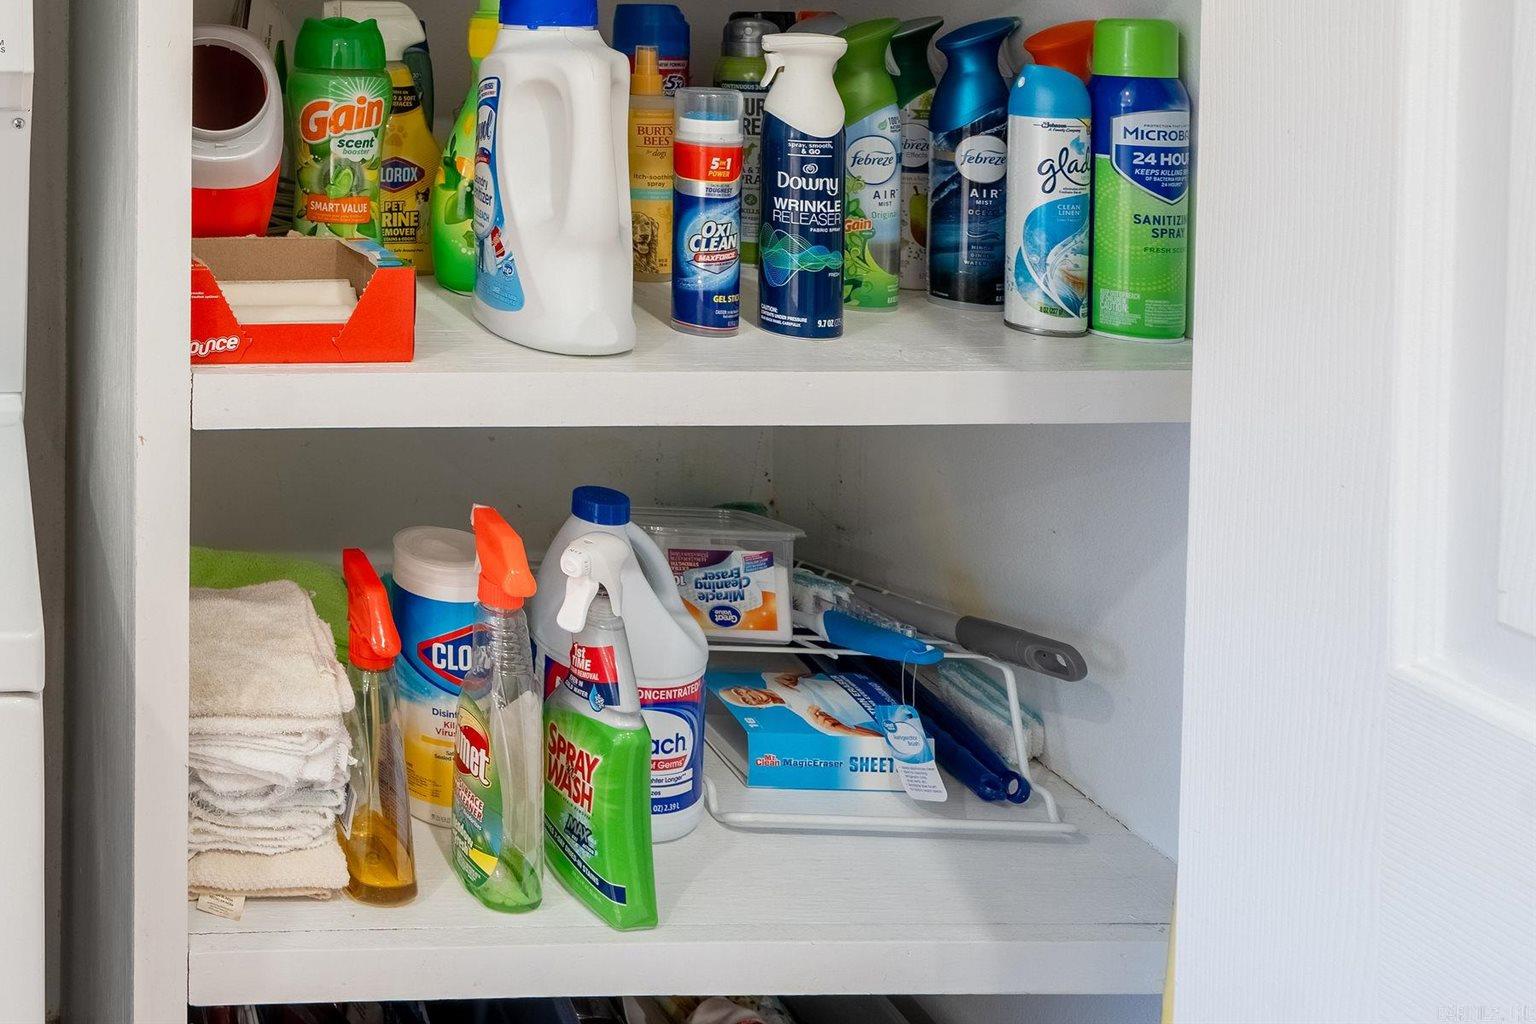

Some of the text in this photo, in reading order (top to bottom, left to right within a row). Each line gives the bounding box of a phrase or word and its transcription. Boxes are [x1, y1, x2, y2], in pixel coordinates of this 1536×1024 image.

[300, 96, 383, 142] Gain
[337, 137, 375, 148] scent
[644, 136, 670, 146] BEES
[788, 142, 834, 150] spray, smooth,
[850, 150, 894, 168] febreze
[961, 149, 1006, 166] febreze
[1132, 152, 1156, 165] 24
[380, 167, 418, 182] LOROX
[1134, 168, 1160, 176] KEEPS
[646, 181, 666, 190] spray
[777, 170, 839, 196] Downy
[873, 189, 896, 200] AIR
[970, 188, 998, 198] AIR
[310, 200, 368, 213] SMART VALUE
[384, 201, 404, 212] PET
[774, 196, 841, 216] WRINKLE
[383, 212, 419, 227] RINE
[772, 210, 841, 226] RELEASER
[702, 221, 732, 238] OXI
[845, 219, 872, 233] Gain
[1152, 227, 1184, 238] SPRAY
[690, 234, 738, 253] CLEAN
[1144, 246, 1171, 254] FRESH
[699, 252, 736, 262] MAXFORCE
[713, 296, 726, 304] GEL
[817, 320, 827, 328] 9.7
[190, 336, 238, 356] ounce
[702, 567, 741, 581] Eraser
[694, 576, 751, 592] Cleaning
[698, 589, 745, 603] Miracle
[714, 614, 738, 623] Great
[572, 655, 592, 672] TIME
[638, 681, 699, 700] ONCENTRATED
[548, 722, 600, 784] SPRAY
[756, 758, 780, 767] Clean
[546, 752, 594, 816] WASH
[565, 814, 592, 844] MAX
